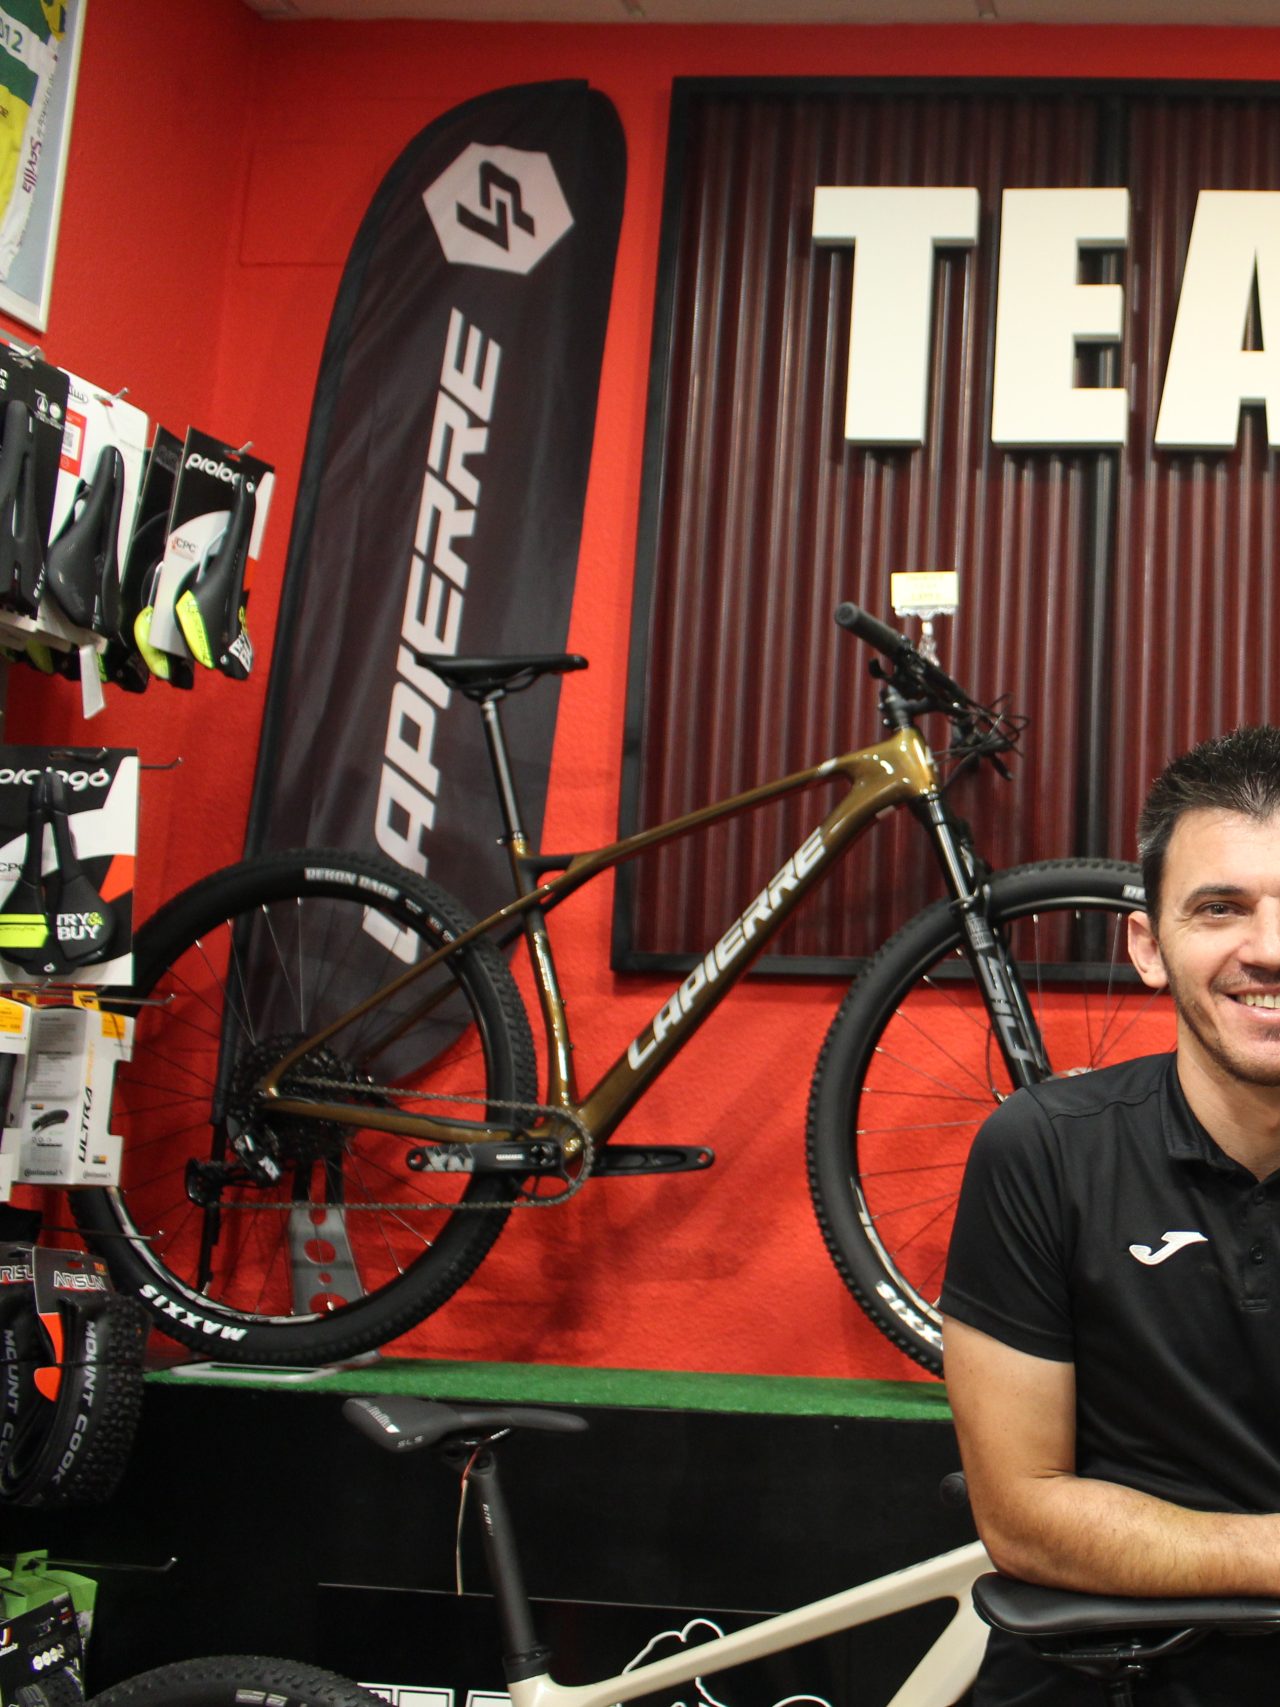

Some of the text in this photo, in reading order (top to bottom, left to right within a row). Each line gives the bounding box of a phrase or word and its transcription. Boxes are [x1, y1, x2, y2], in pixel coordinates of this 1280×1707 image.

[58, 926, 99, 940] BUY
[627, 826, 828, 1071] LAPIERRE
[78, 1086, 93, 1163] ULTRA
[53, 1270, 108, 1292] ARISUN
[139, 1283, 248, 1341] MAXXIS
[52, 1320, 98, 1485] MOUNT COOK
